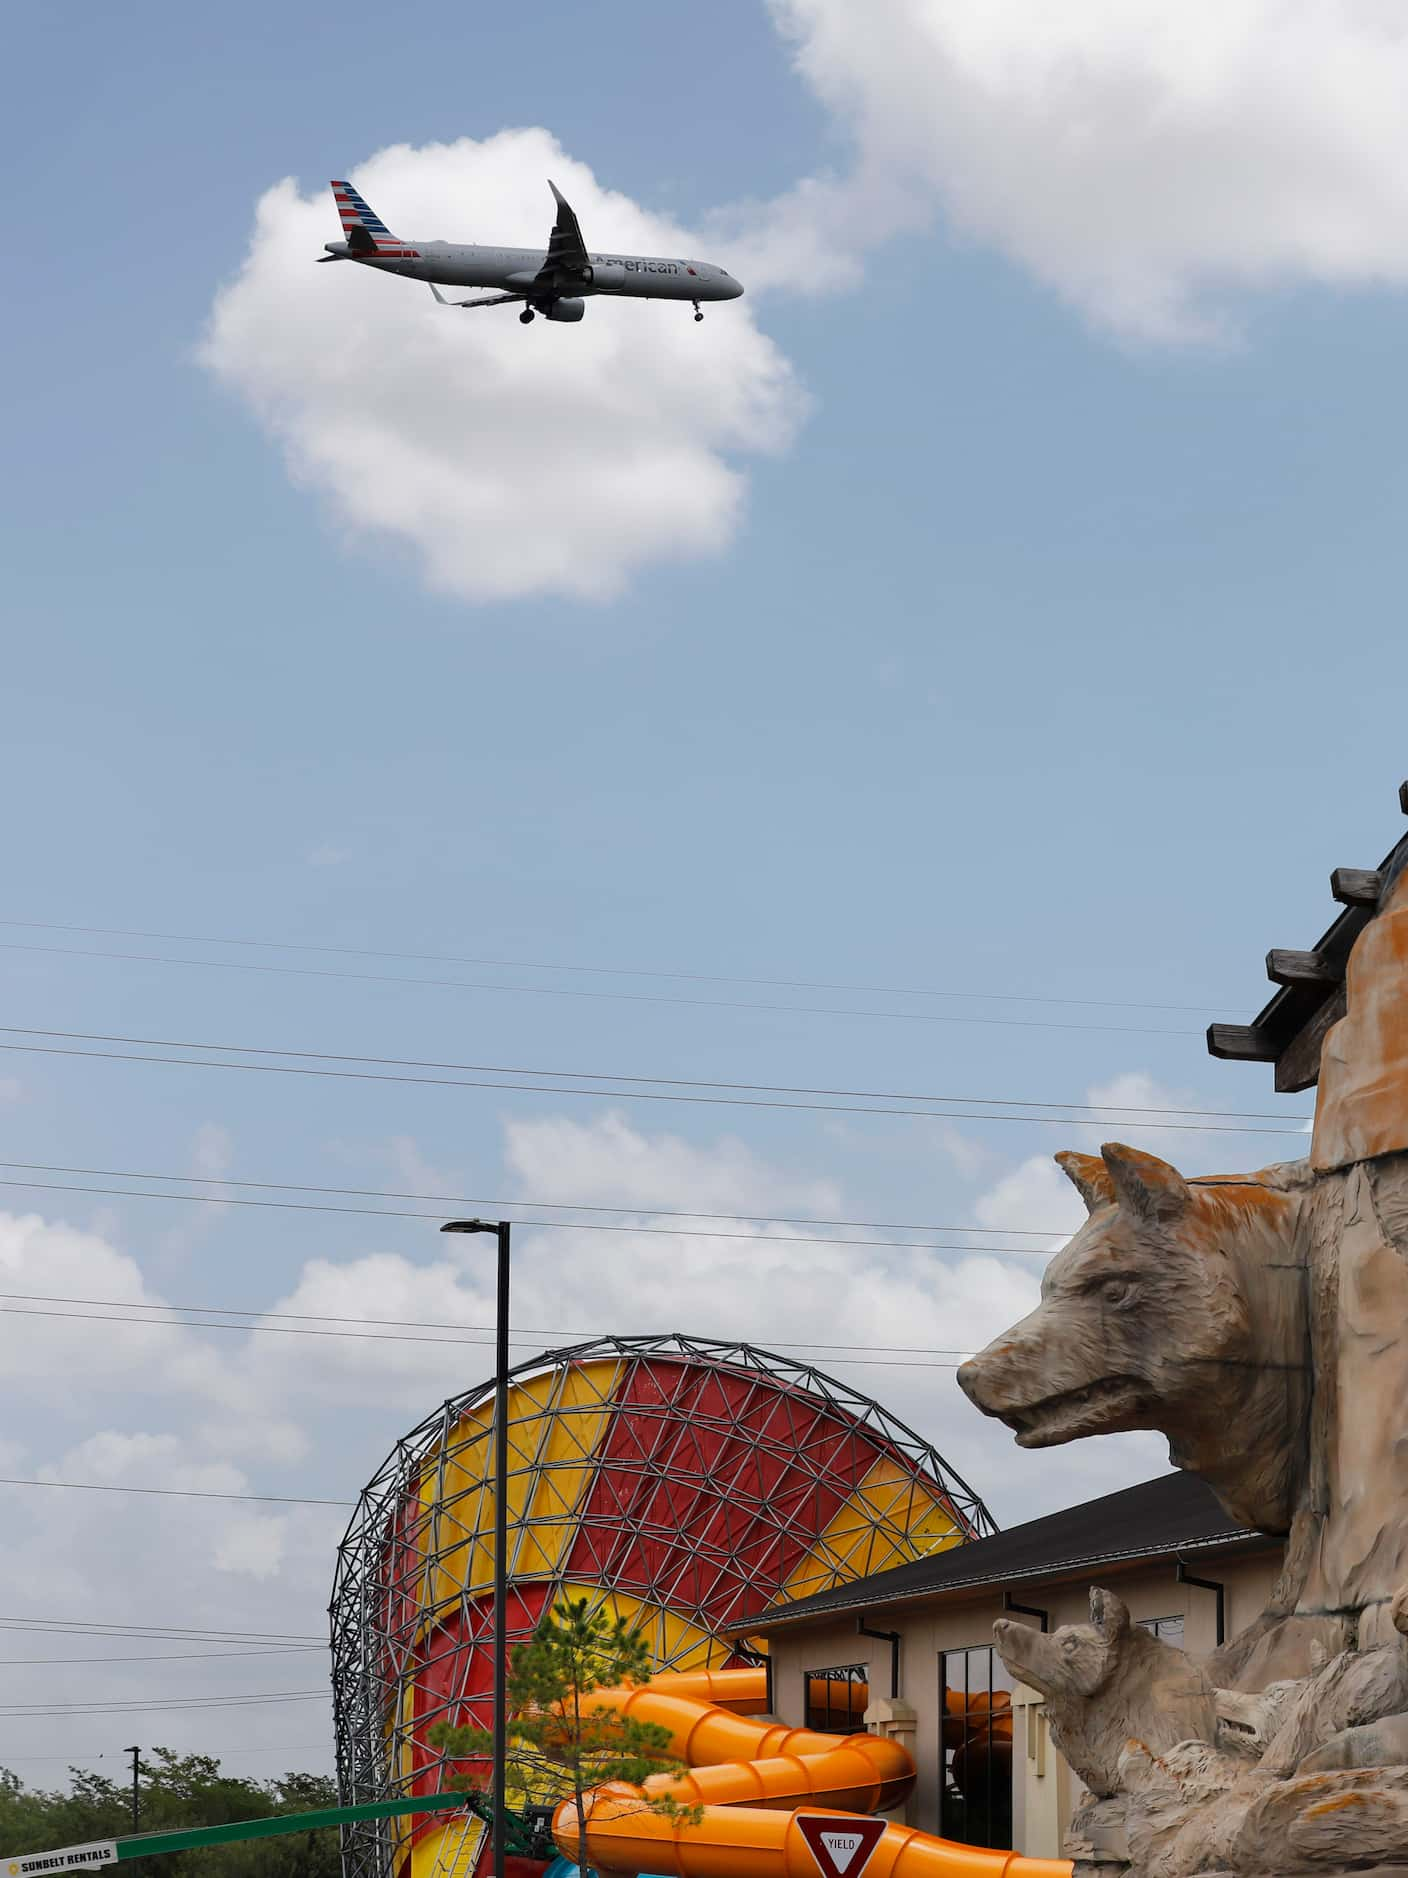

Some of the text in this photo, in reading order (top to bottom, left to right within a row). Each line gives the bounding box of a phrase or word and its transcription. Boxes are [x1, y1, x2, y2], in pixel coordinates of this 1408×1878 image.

[828, 1838, 855, 1850] YIELD
[21, 1849, 111, 1873] SUNBELT RENTALS
